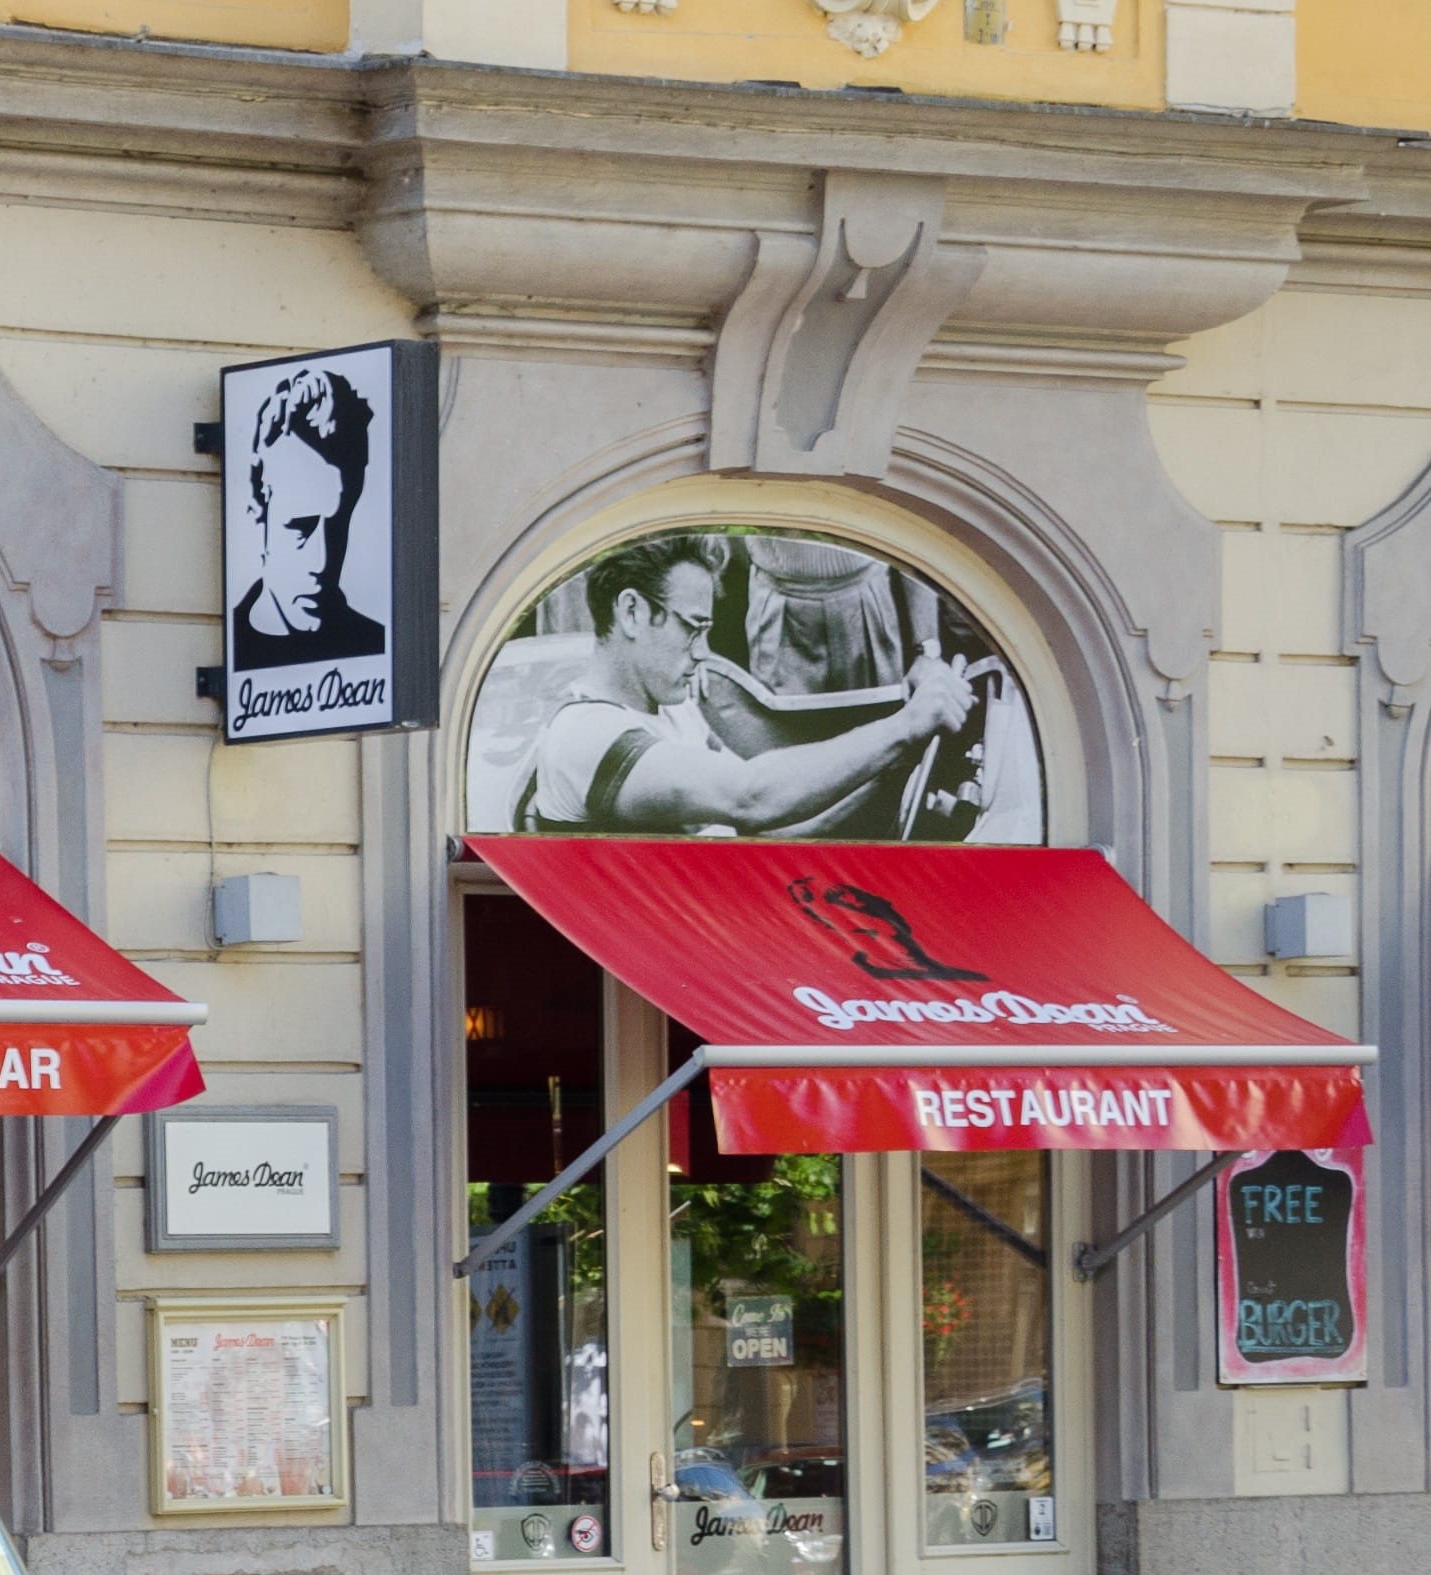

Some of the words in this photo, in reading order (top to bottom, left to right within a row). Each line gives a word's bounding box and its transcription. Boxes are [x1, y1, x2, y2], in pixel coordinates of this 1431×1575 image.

[234, 678, 313, 731] James
[317, 667, 387, 712] Dean
[792, 985, 995, 1031] James
[981, 989, 1160, 1026] Dean
[1087, 1022, 1179, 1034] PRAGUE
[915, 1088, 1172, 1128] RESTAURANT
[188, 1161, 251, 1194] James
[252, 1160, 304, 1188] Dean
[1240, 1184, 1324, 1224] FREE
[1239, 1299, 1344, 1347] BURGER
[170, 1337, 199, 1348] MENU
[731, 1337, 788, 1360] OPEN
[766, 1502, 824, 1536] Dean
